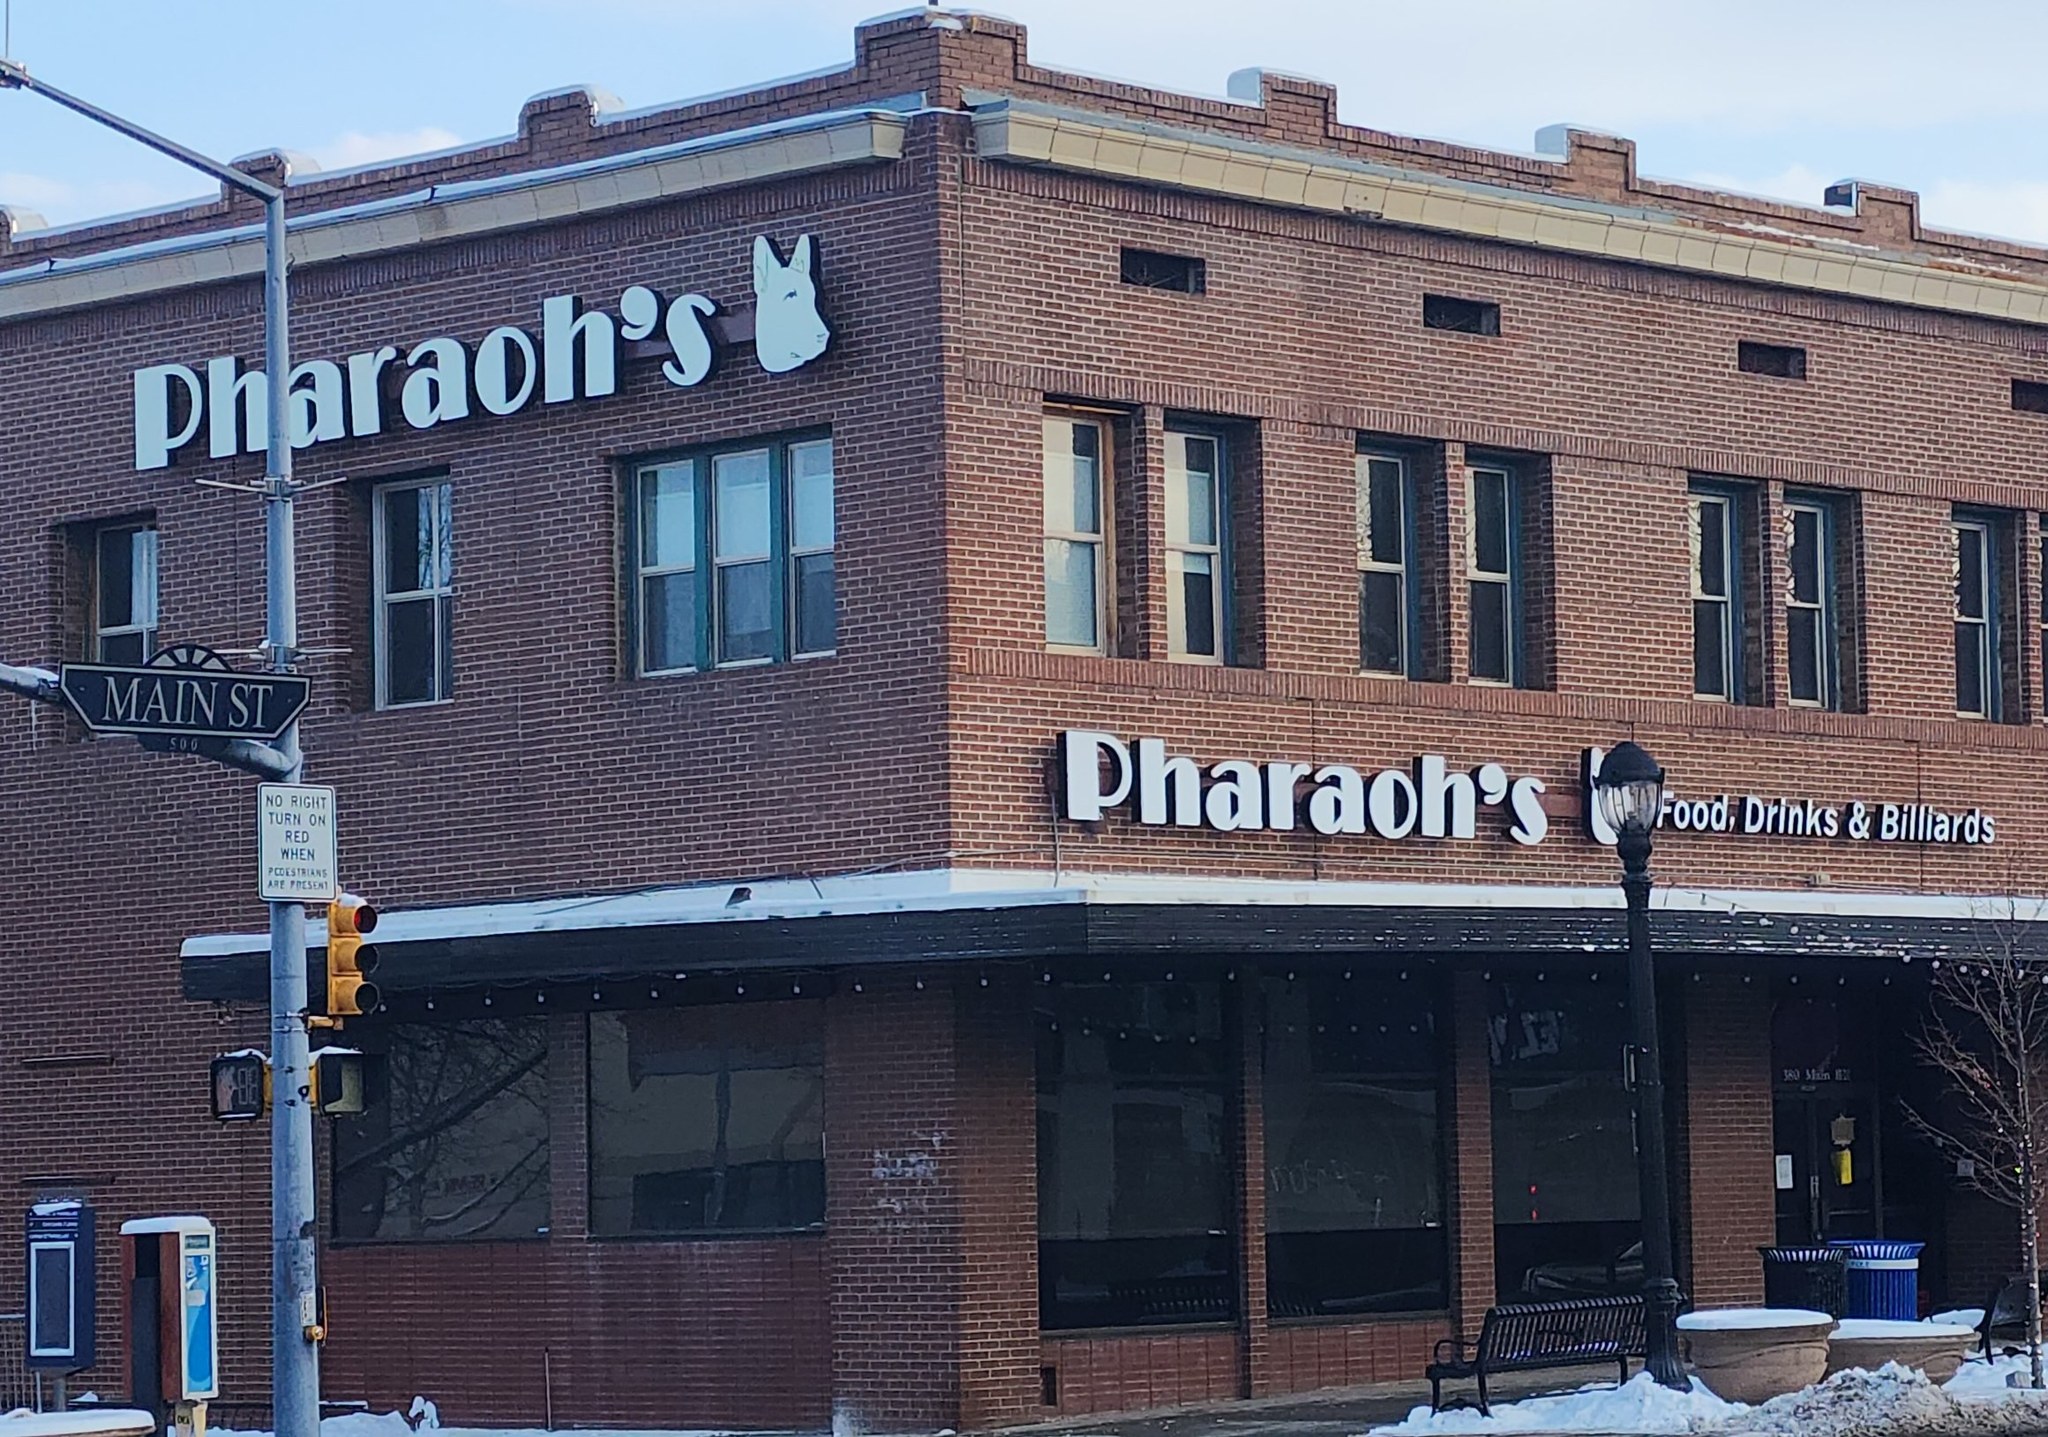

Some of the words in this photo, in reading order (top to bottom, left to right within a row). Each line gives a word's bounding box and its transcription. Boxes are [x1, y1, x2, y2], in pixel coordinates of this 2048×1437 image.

[134, 285, 716, 470] Pharaoh's
[101, 676, 219, 726] MAIN
[228, 683, 274, 728] ST
[169, 737, 198, 750] 500
[1064, 729, 1548, 845] Pharaoh's
[266, 794, 283, 808] NO
[290, 795, 327, 809] RIGHT
[268, 811, 301, 826] TURN
[309, 813, 326, 827] ON
[1656, 790, 1736, 833] Food,
[1744, 795, 1839, 838] Drinks
[1848, 800, 1871, 841] &
[1880, 803, 1996, 844] Billiards
[285, 830, 310, 843] RED
[281, 847, 315, 861] WHEN
[267, 867, 328, 878] PEDESTRIANS
[267, 880, 285, 890] ARE
[290, 881, 328, 891] PRESENT
